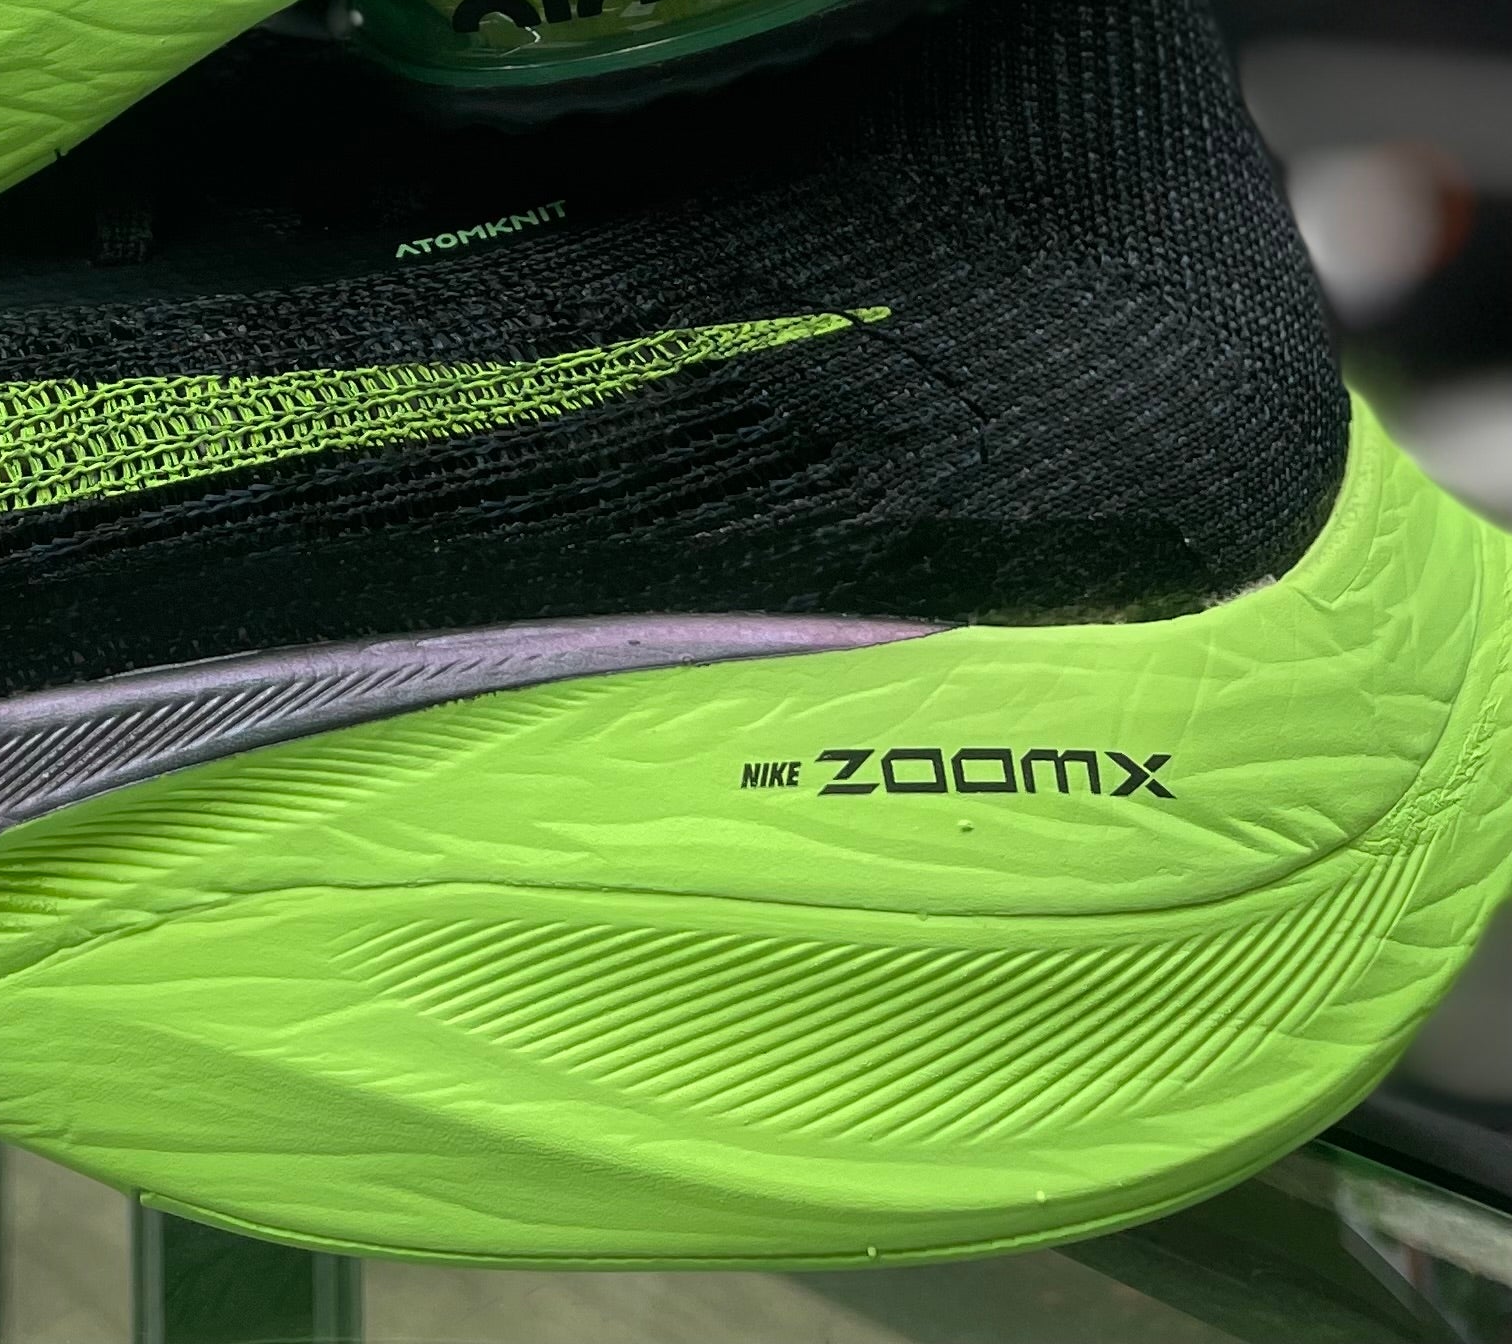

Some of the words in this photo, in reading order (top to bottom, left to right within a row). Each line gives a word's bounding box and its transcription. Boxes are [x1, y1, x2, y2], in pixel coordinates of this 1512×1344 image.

[395, 199, 566, 258] ATOMKNIT
[740, 760, 802, 789] NIKE
[814, 748, 1177, 799] ZOOMX
